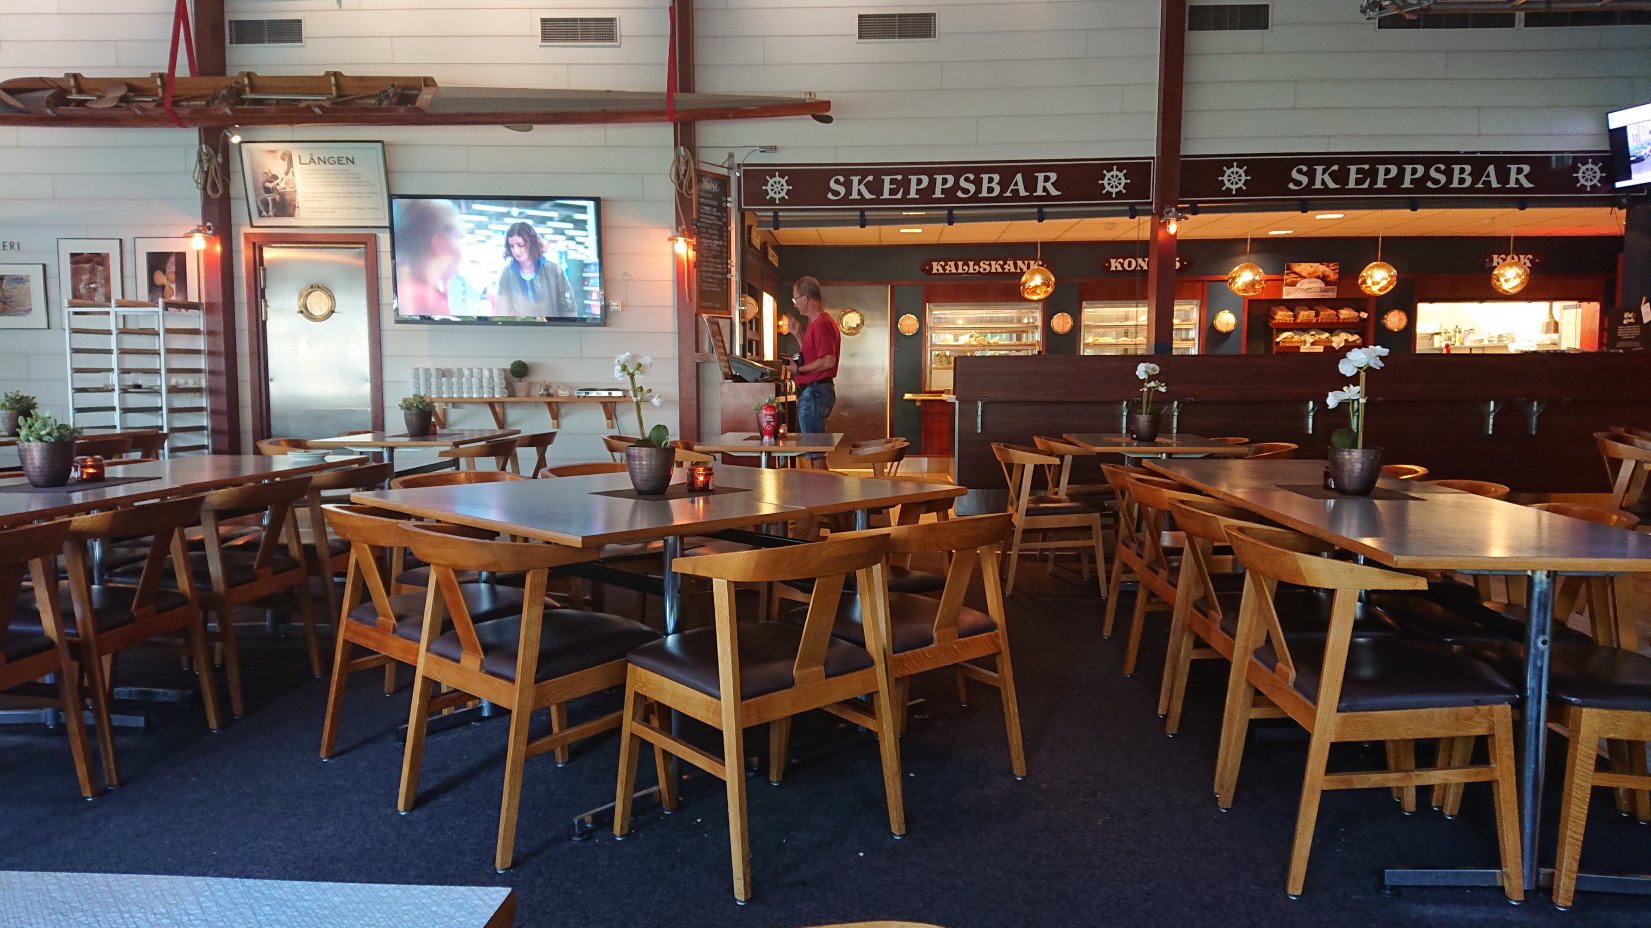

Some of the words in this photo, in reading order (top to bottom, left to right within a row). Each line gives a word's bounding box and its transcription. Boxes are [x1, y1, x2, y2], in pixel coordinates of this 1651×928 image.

[298, 153, 355, 165] LÅNGEN
[827, 172, 1062, 200] SKEPPSBAR
[1288, 163, 1535, 190] SKEPPSBAR
[2, 241, 20, 251] ERI
